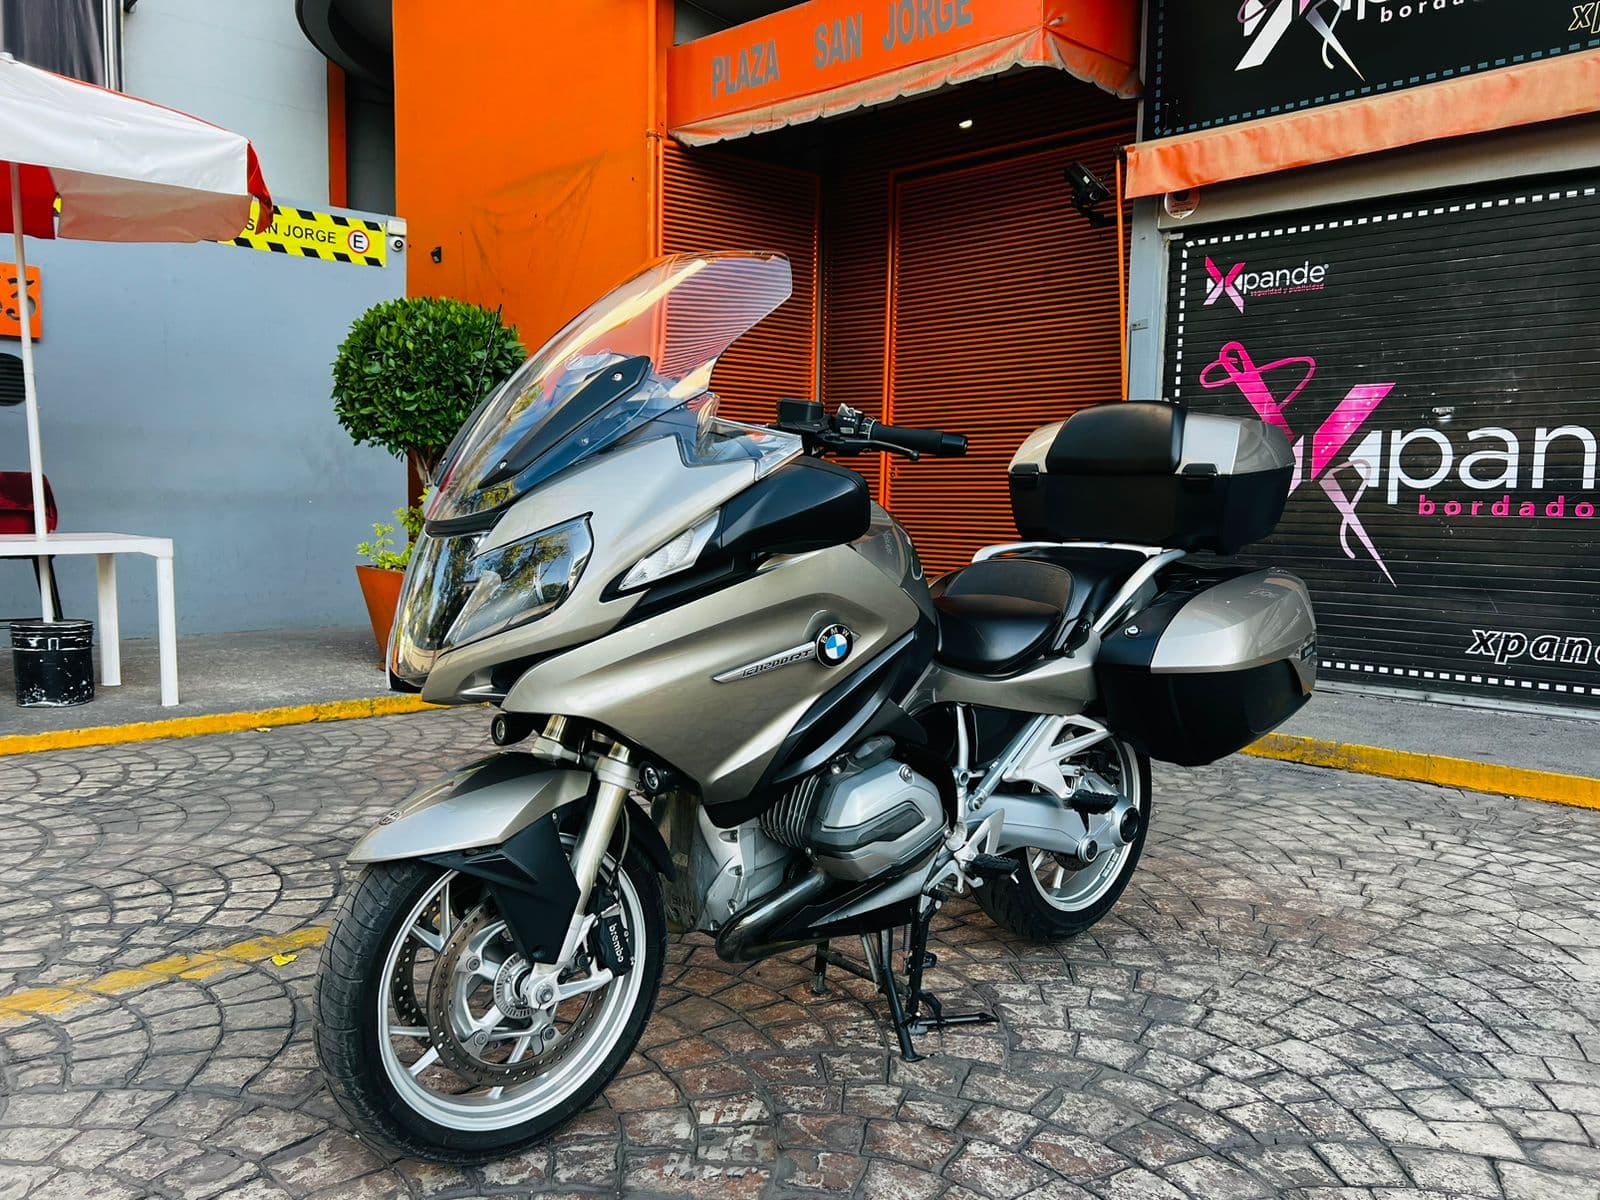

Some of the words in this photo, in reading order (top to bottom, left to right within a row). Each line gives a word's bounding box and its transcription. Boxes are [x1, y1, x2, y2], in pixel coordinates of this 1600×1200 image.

[1380, 0, 1483, 23] bord
[711, 39, 779, 97] PLAZA
[813, 12, 863, 69] SAN
[881, 0, 974, 51] JORGE
[245, 218, 278, 235] SN
[283, 224, 337, 245] JORGE
[352, 234, 365, 250] E
[0, 276, 36, 321] 3
[1418, 494, 1595, 518] bordado
[820, 626, 850, 645] BMW
[1465, 629, 1600, 665] xpan
[609, 923, 624, 963] brembo
